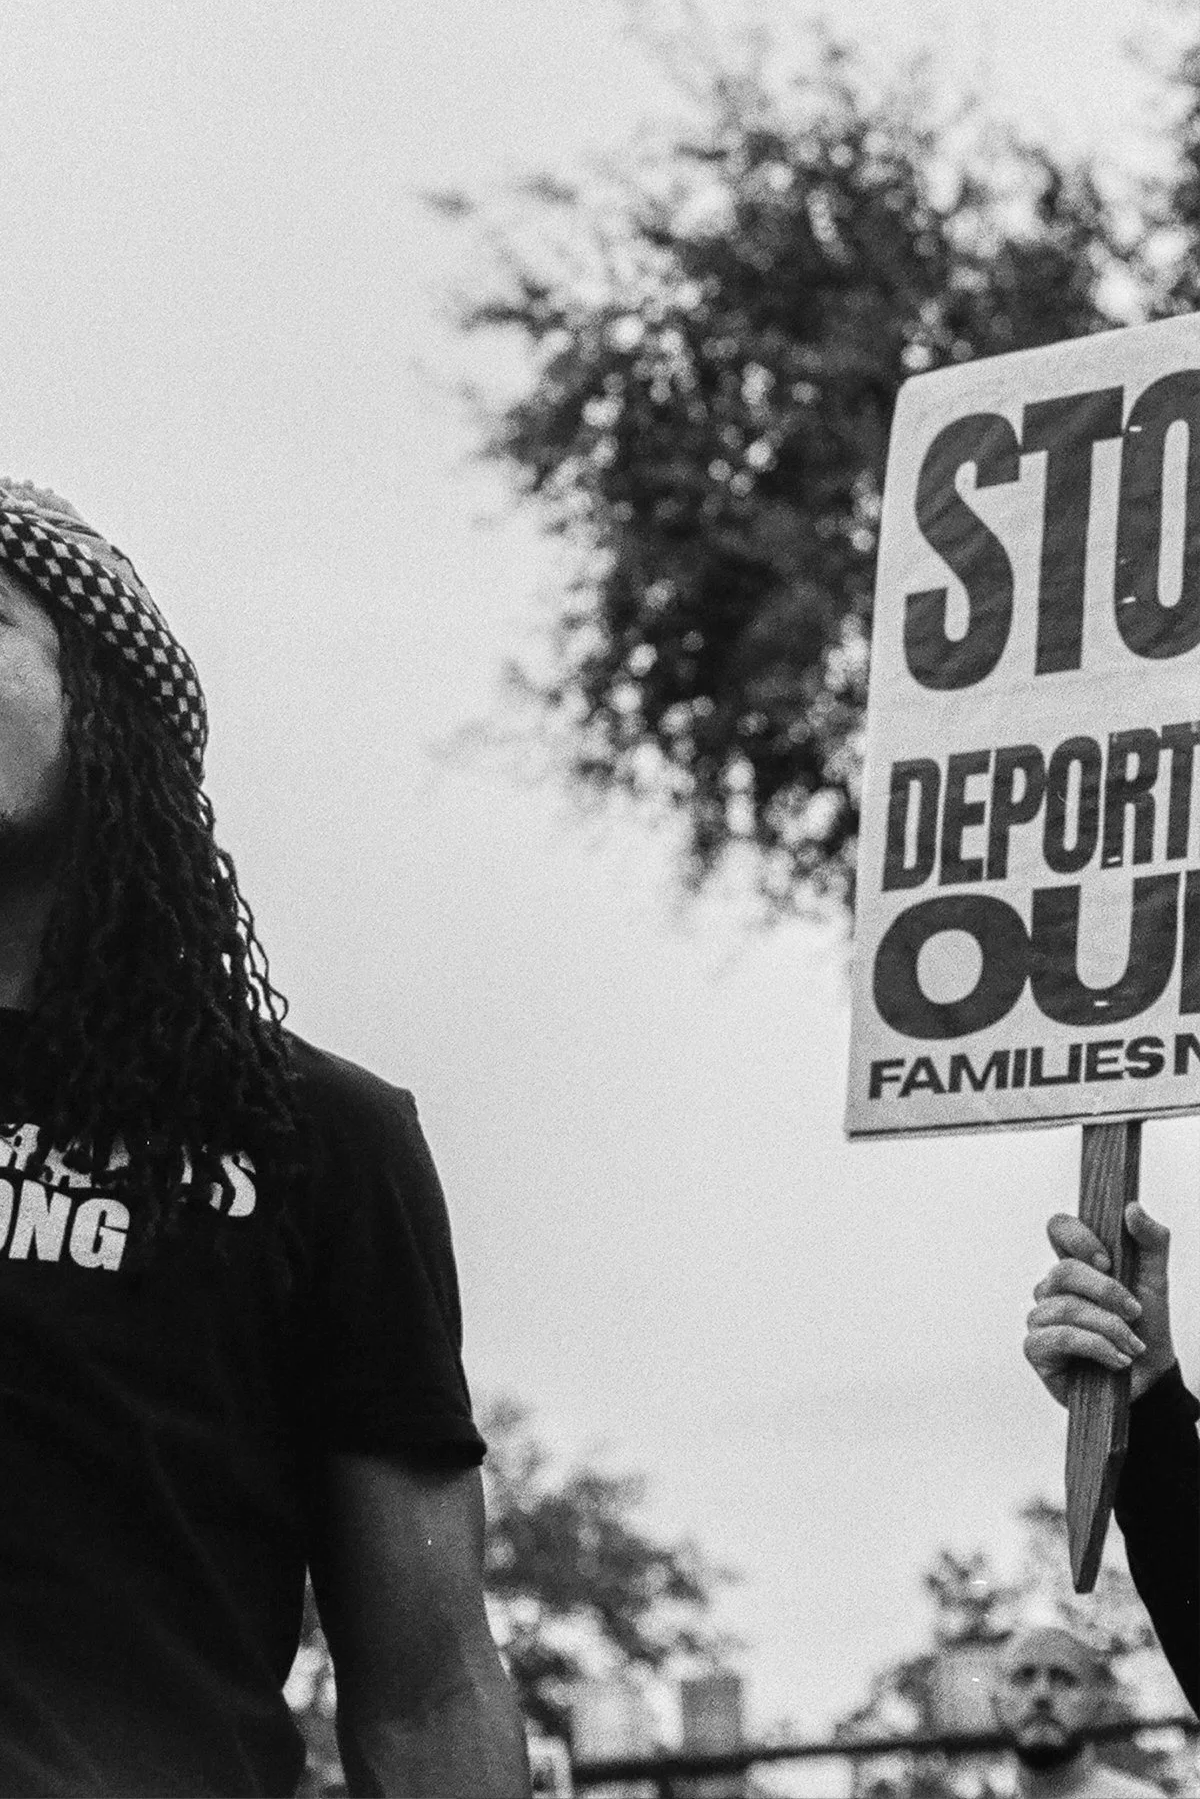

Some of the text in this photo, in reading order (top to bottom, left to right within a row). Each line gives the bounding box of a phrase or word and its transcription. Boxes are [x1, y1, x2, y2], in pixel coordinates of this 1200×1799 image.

[882, 722, 1200, 892] DEPORT
[873, 869, 1200, 1040] OU
[868, 1035, 1166, 1100] FAMILIES
